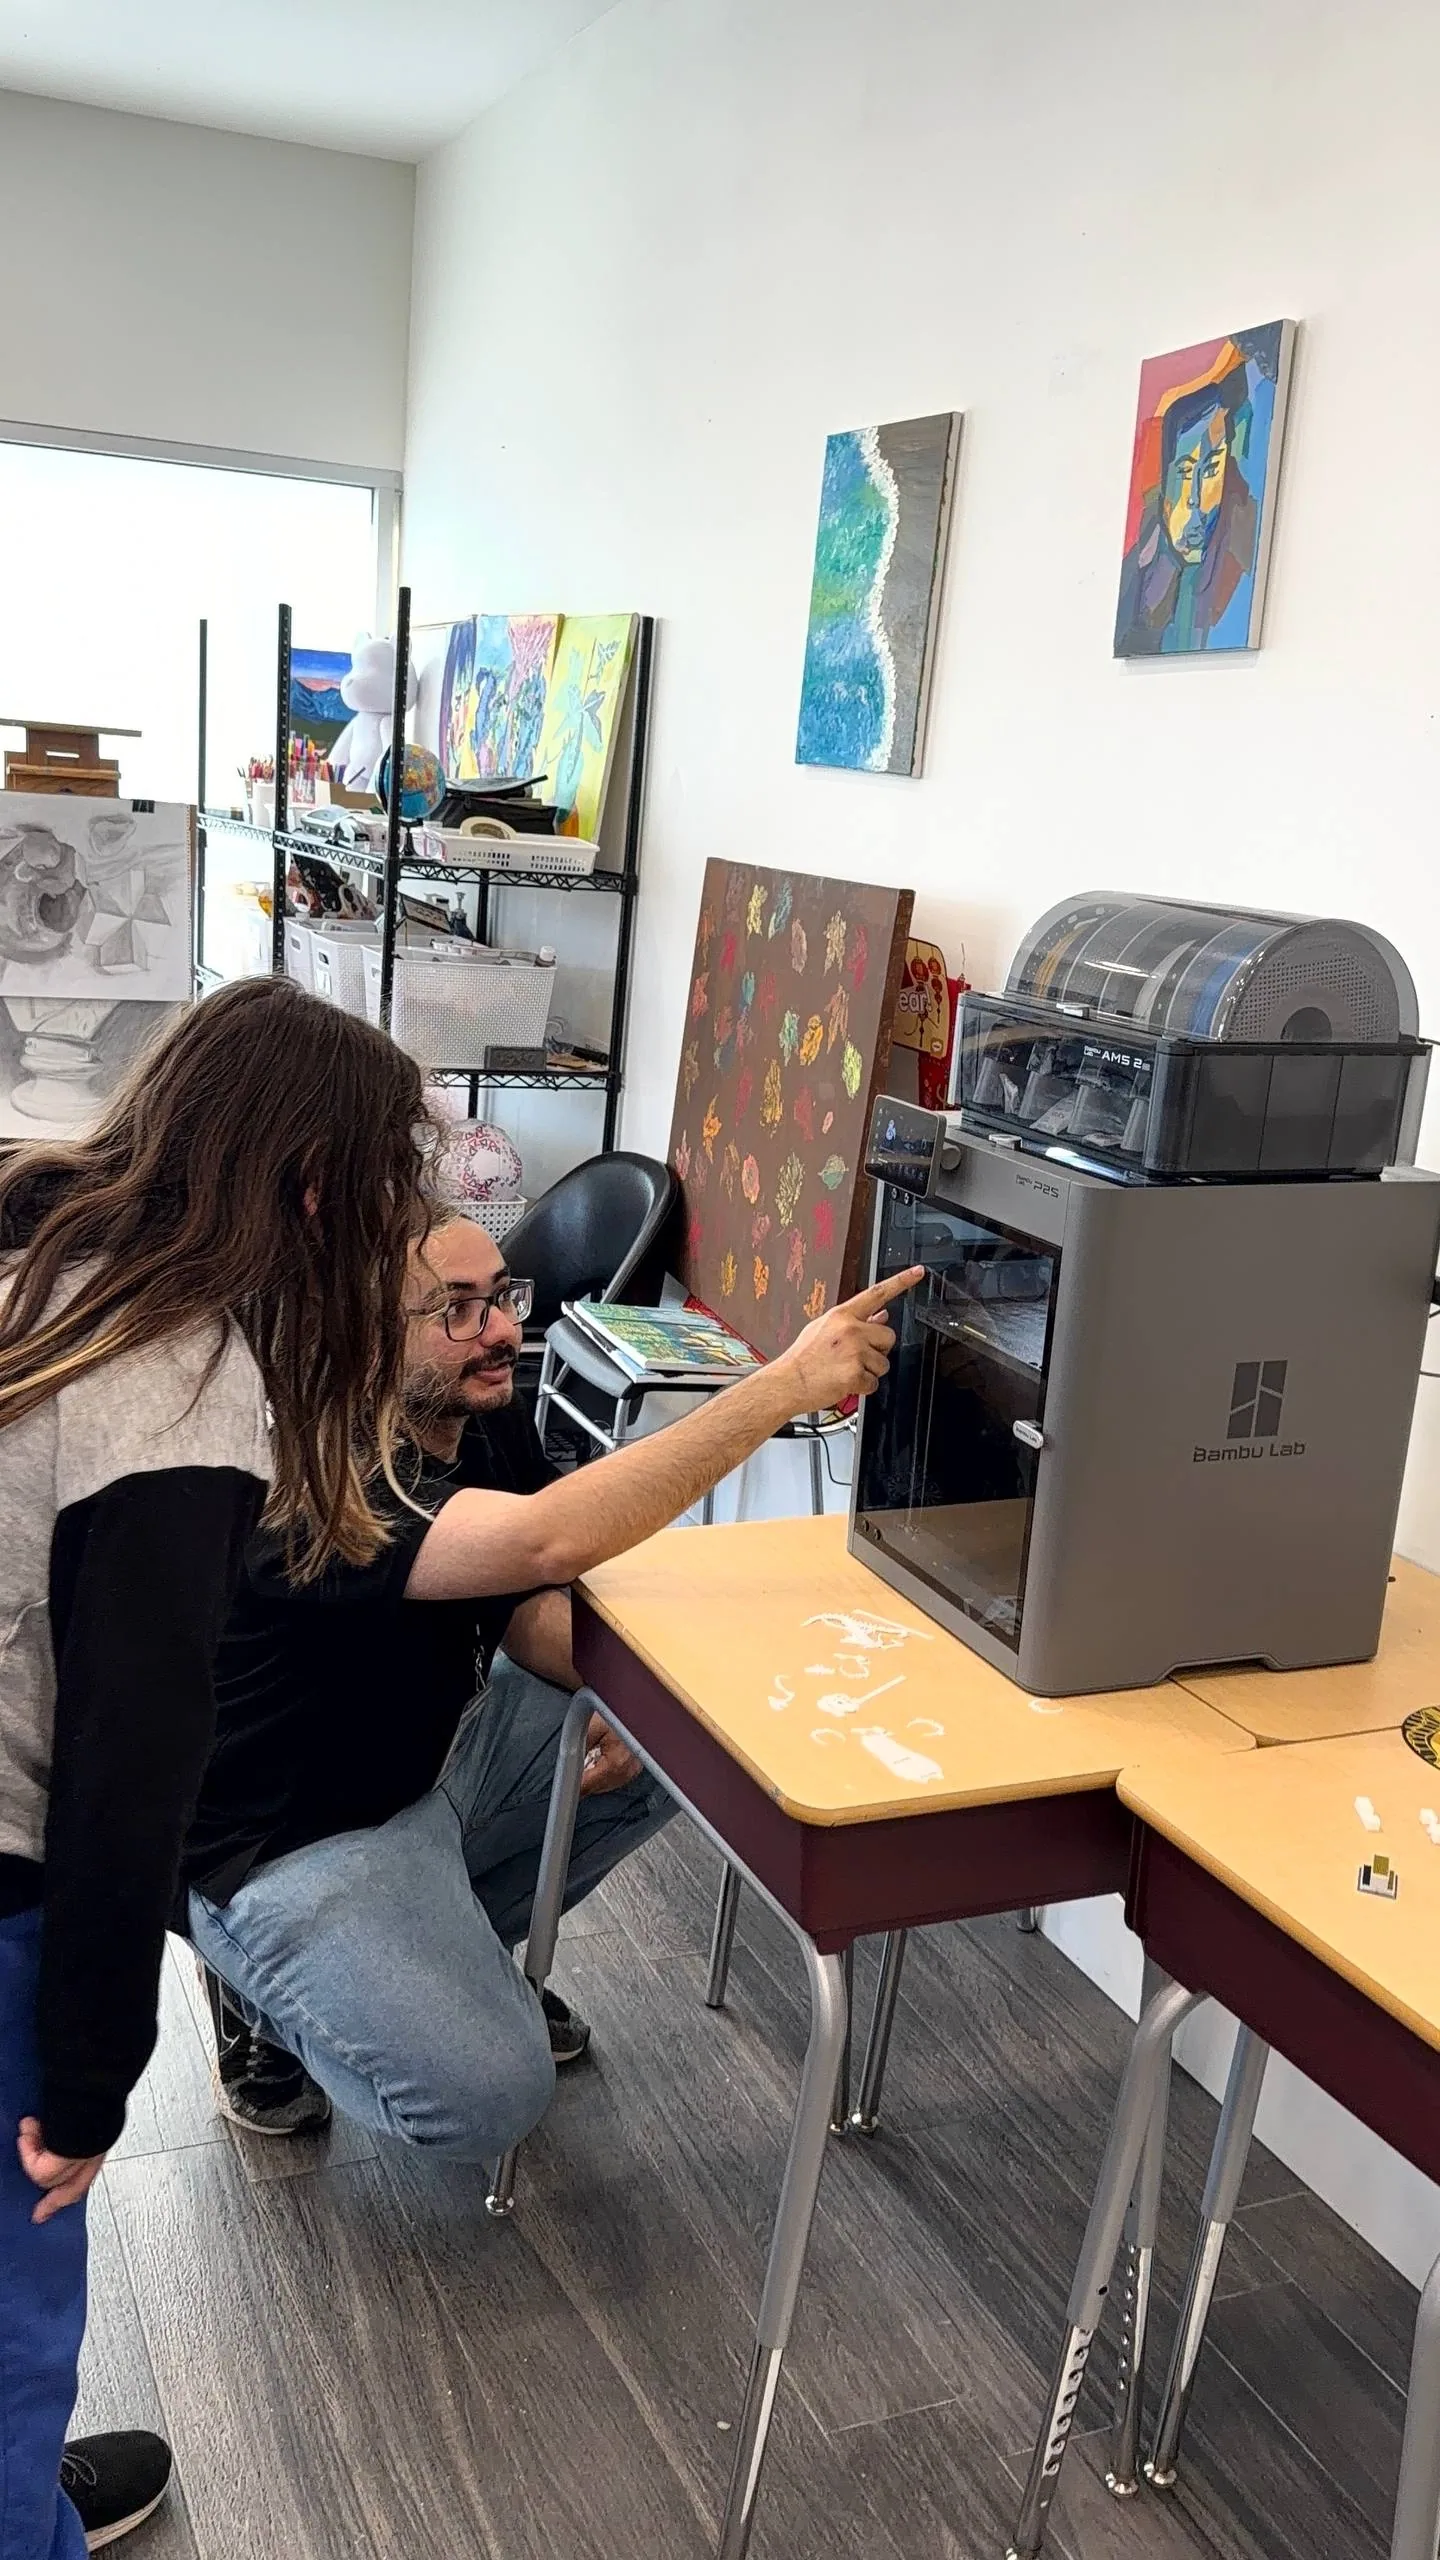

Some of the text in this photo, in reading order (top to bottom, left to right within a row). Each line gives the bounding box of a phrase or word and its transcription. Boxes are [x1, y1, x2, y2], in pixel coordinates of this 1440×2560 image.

[899, 987, 932, 1014] ear!
[1101, 1050, 1131, 1066] AMS
[1133, 1058, 1143, 1069] 2
[1193, 1442, 1306, 1463] Bambu Lab
